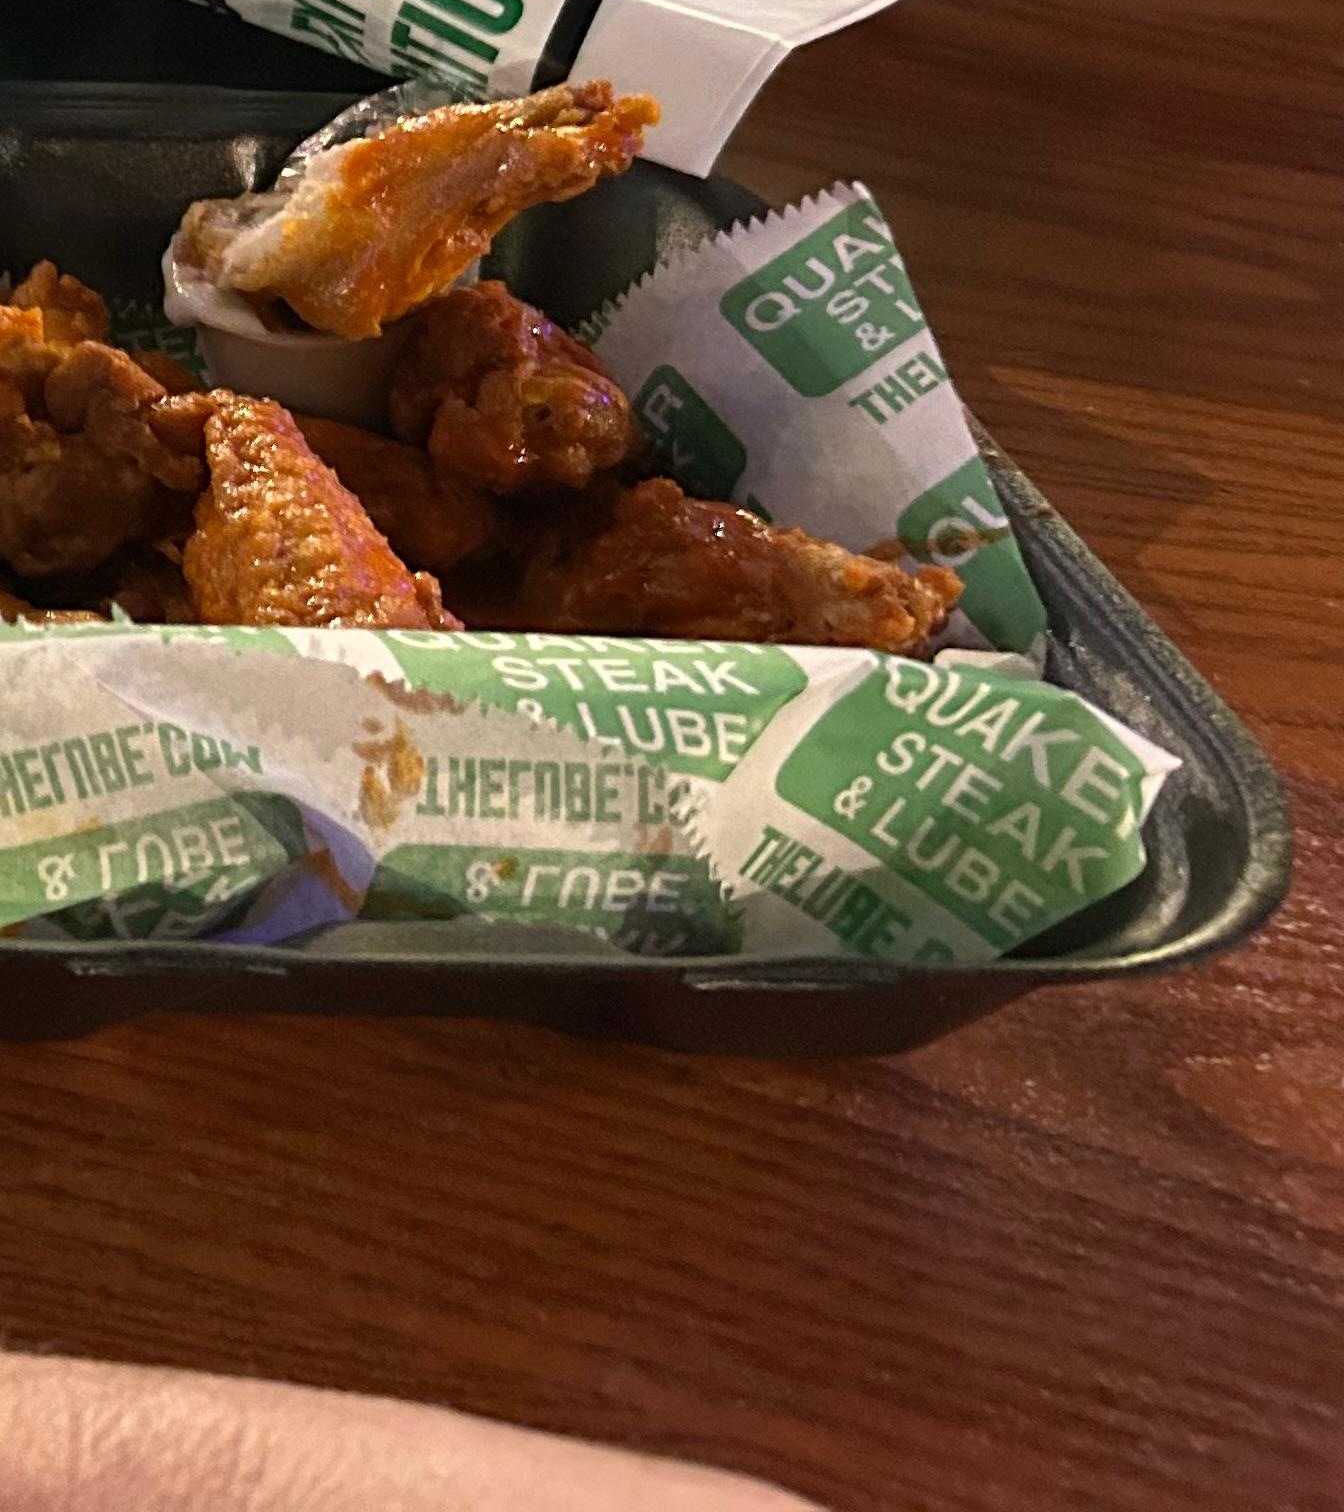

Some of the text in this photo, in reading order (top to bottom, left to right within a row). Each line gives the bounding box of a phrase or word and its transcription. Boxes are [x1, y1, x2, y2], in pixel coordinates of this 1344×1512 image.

[855, 321, 897, 352] &
[492, 656, 760, 696] STEAK
[576, 701, 750, 764] LUBE
[875, 731, 1111, 894] STEAK
[833, 774, 1046, 936] & LUBE
